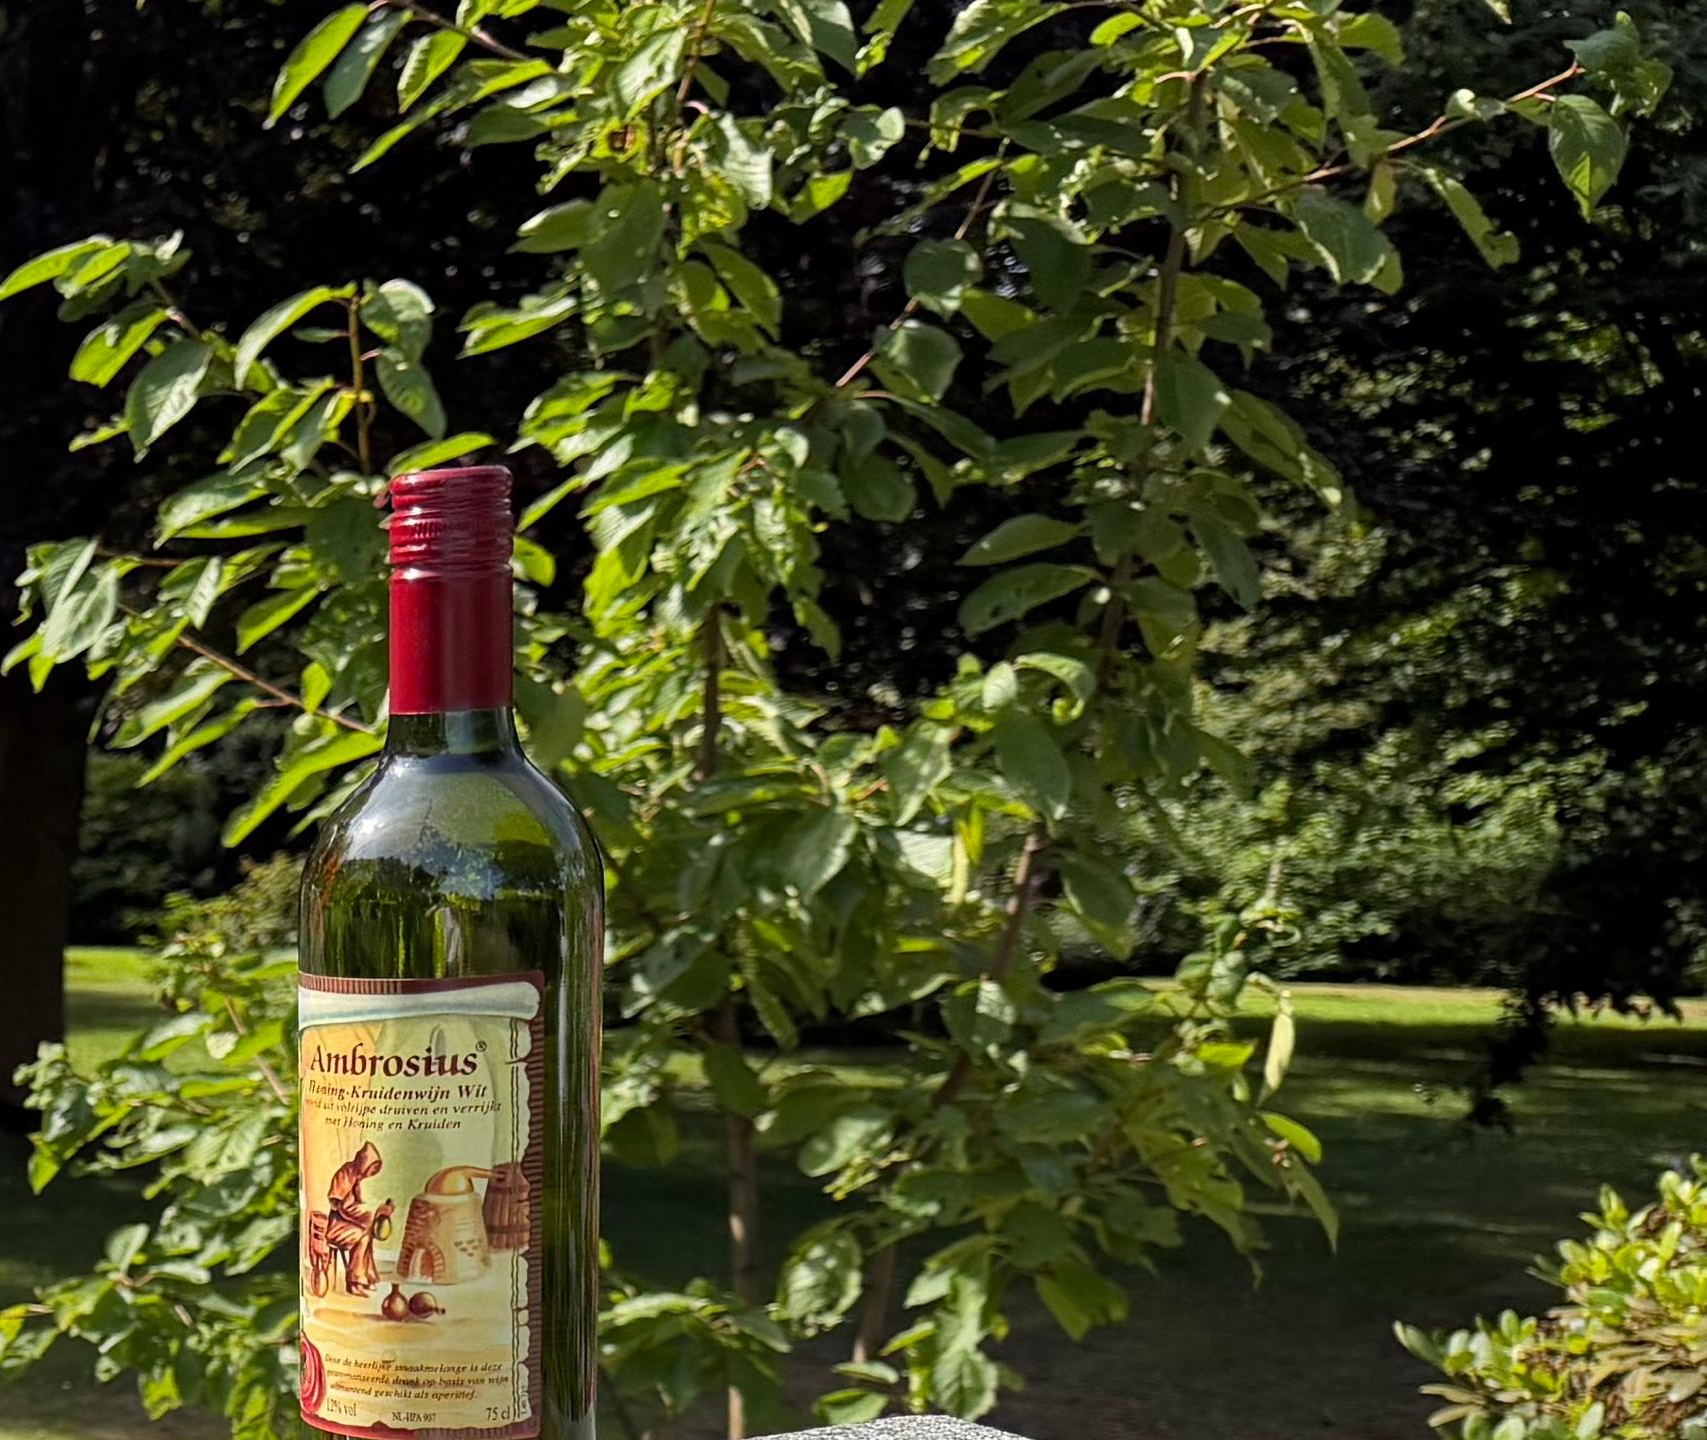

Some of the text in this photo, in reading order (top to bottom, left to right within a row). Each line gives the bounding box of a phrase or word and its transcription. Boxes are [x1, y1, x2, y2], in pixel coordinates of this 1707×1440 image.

[310, 1043, 477, 1077] Ambrosius
[458, 1084, 487, 1098] Wit
[380, 1103, 427, 1115] druiven
[433, 1106, 448, 1115] en
[388, 1121, 402, 1130] en
[408, 1119, 461, 1130] Kruiden
[486, 1406, 498, 1421] 75
